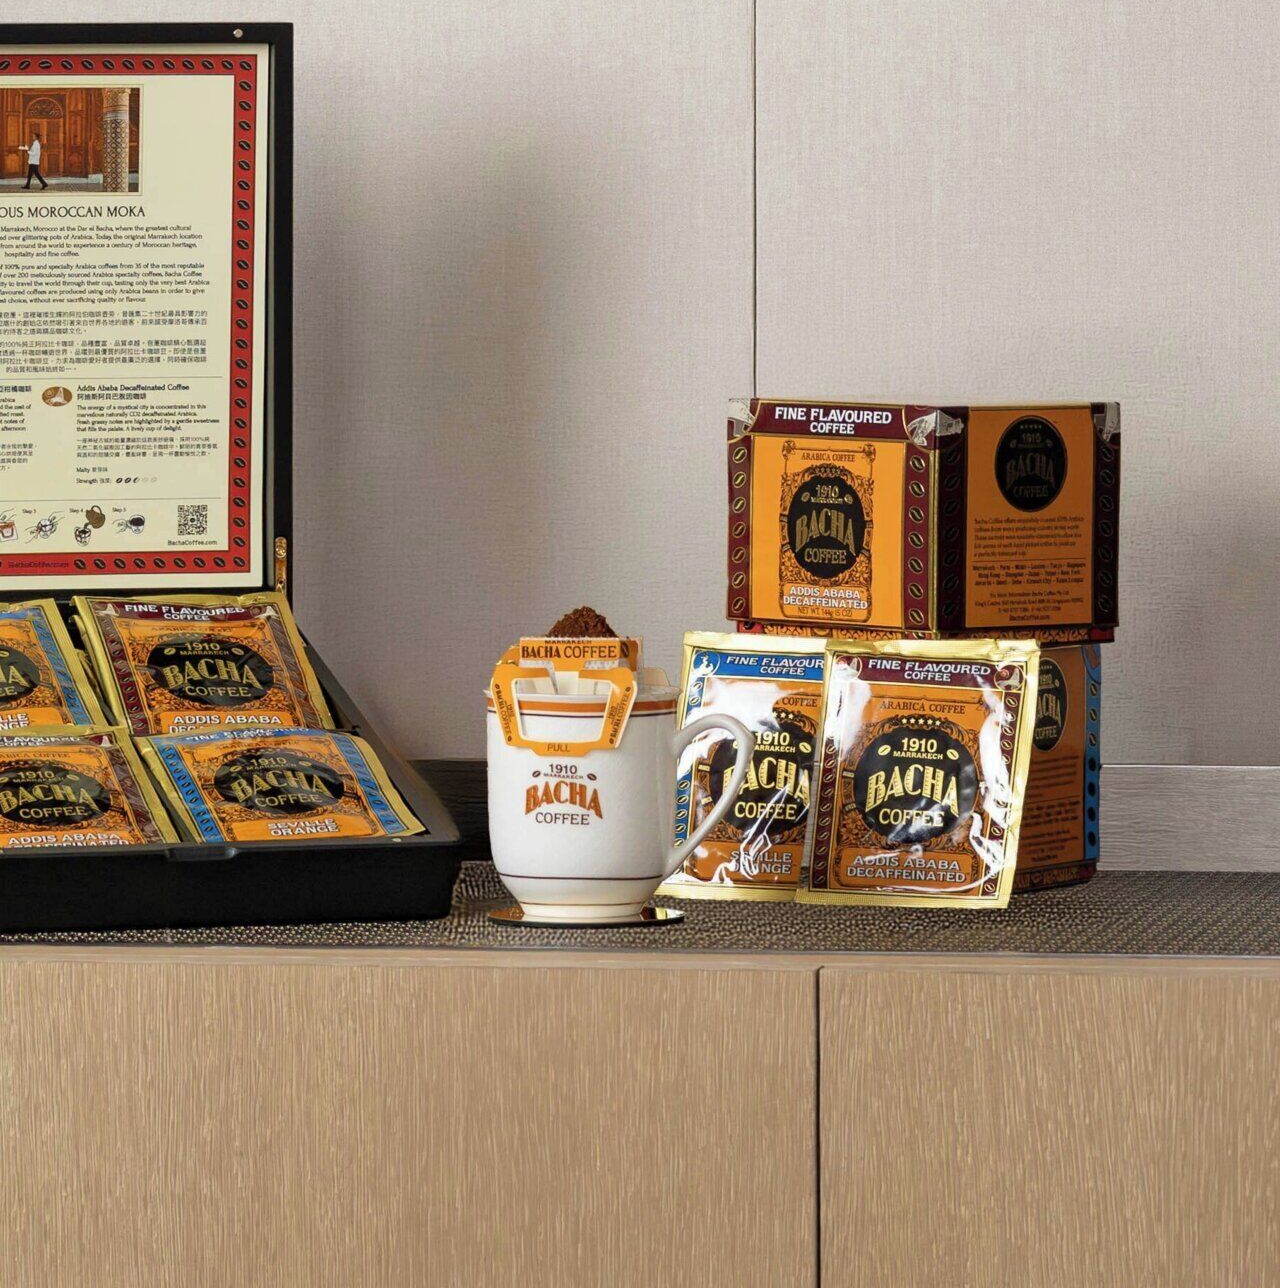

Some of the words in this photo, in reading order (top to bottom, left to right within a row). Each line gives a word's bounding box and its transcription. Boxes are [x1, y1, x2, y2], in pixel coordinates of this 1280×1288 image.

[27, 205, 102, 217] MOROCCAN
[106, 205, 145, 217] MOKA
[22, 234, 48, 242] glittering
[49, 234, 61, 242] pots
[124, 233, 147, 241] original
[775, 407, 806, 420] FINE
[810, 409, 892, 424] FLAVOURED
[810, 423, 855, 435] COFFEE
[801, 453, 832, 461] ARABICA
[832, 454, 855, 462] COFFEE
[1006, 454, 1055, 491] BACHA
[815, 485, 839, 497] 1910
[795, 508, 856, 556] BACHA
[804, 548, 847, 564] COFFEE
[789, 586, 820, 596] ADDIS
[822, 588, 861, 598] ABABA
[783, 596, 868, 609] DECAFFEINATED
[124, 604, 158, 613] FINE
[162, 606, 246, 616] FLAVOURED
[184, 642, 220, 651] 1910
[522, 646, 561, 659] BACHA
[564, 645, 617, 658] COFFEE
[726, 656, 759, 665] FINE
[762, 657, 824, 669] FLAVOUR
[868, 659, 901, 670] FINE
[905, 662, 991, 676] FLAVOURED
[163, 658, 261, 689] BACHA
[760, 667, 805, 676] COFFEE
[904, 671, 951, 682] COFFEE
[185, 685, 252, 697] COFFEE
[782, 697, 818, 707] COFFEE
[880, 700, 926, 712] ARABICA
[929, 704, 966, 715] COFFEE
[1037, 693, 1062, 727] ACHA
[173, 715, 220, 724] ADDIS
[225, 714, 282, 724] ABABA
[756, 732, 791, 744] 1910
[1035, 725, 1059, 739] COFFEE
[547, 744, 570, 752] PULL
[754, 745, 796, 753] ARRAKECH
[901, 738, 938, 751] 1910
[893, 751, 944, 760] MARRAKECH
[250, 757, 287, 767] 1910
[17, 771, 55, 779] 1910
[549, 764, 578, 774] 1910
[230, 770, 334, 803] BACHA
[865, 764, 960, 818] BACHA
[255, 795, 324, 808] COFFEE
[525, 780, 603, 820] BACHA
[20, 806, 88, 819] COFFEE
[734, 802, 798, 821] COFFEE
[879, 808, 945, 827] COFFEE
[268, 819, 337, 830] SEVILLE
[535, 812, 590, 826] COFFEE
[270, 826, 339, 836] ORANGE
[8, 835, 58, 845] ADDIS
[62, 833, 121, 841] ABABA
[853, 855, 899, 867] ADDIS
[904, 858, 960, 871] ABABA
[847, 866, 967, 884] DECAFFEINATED
